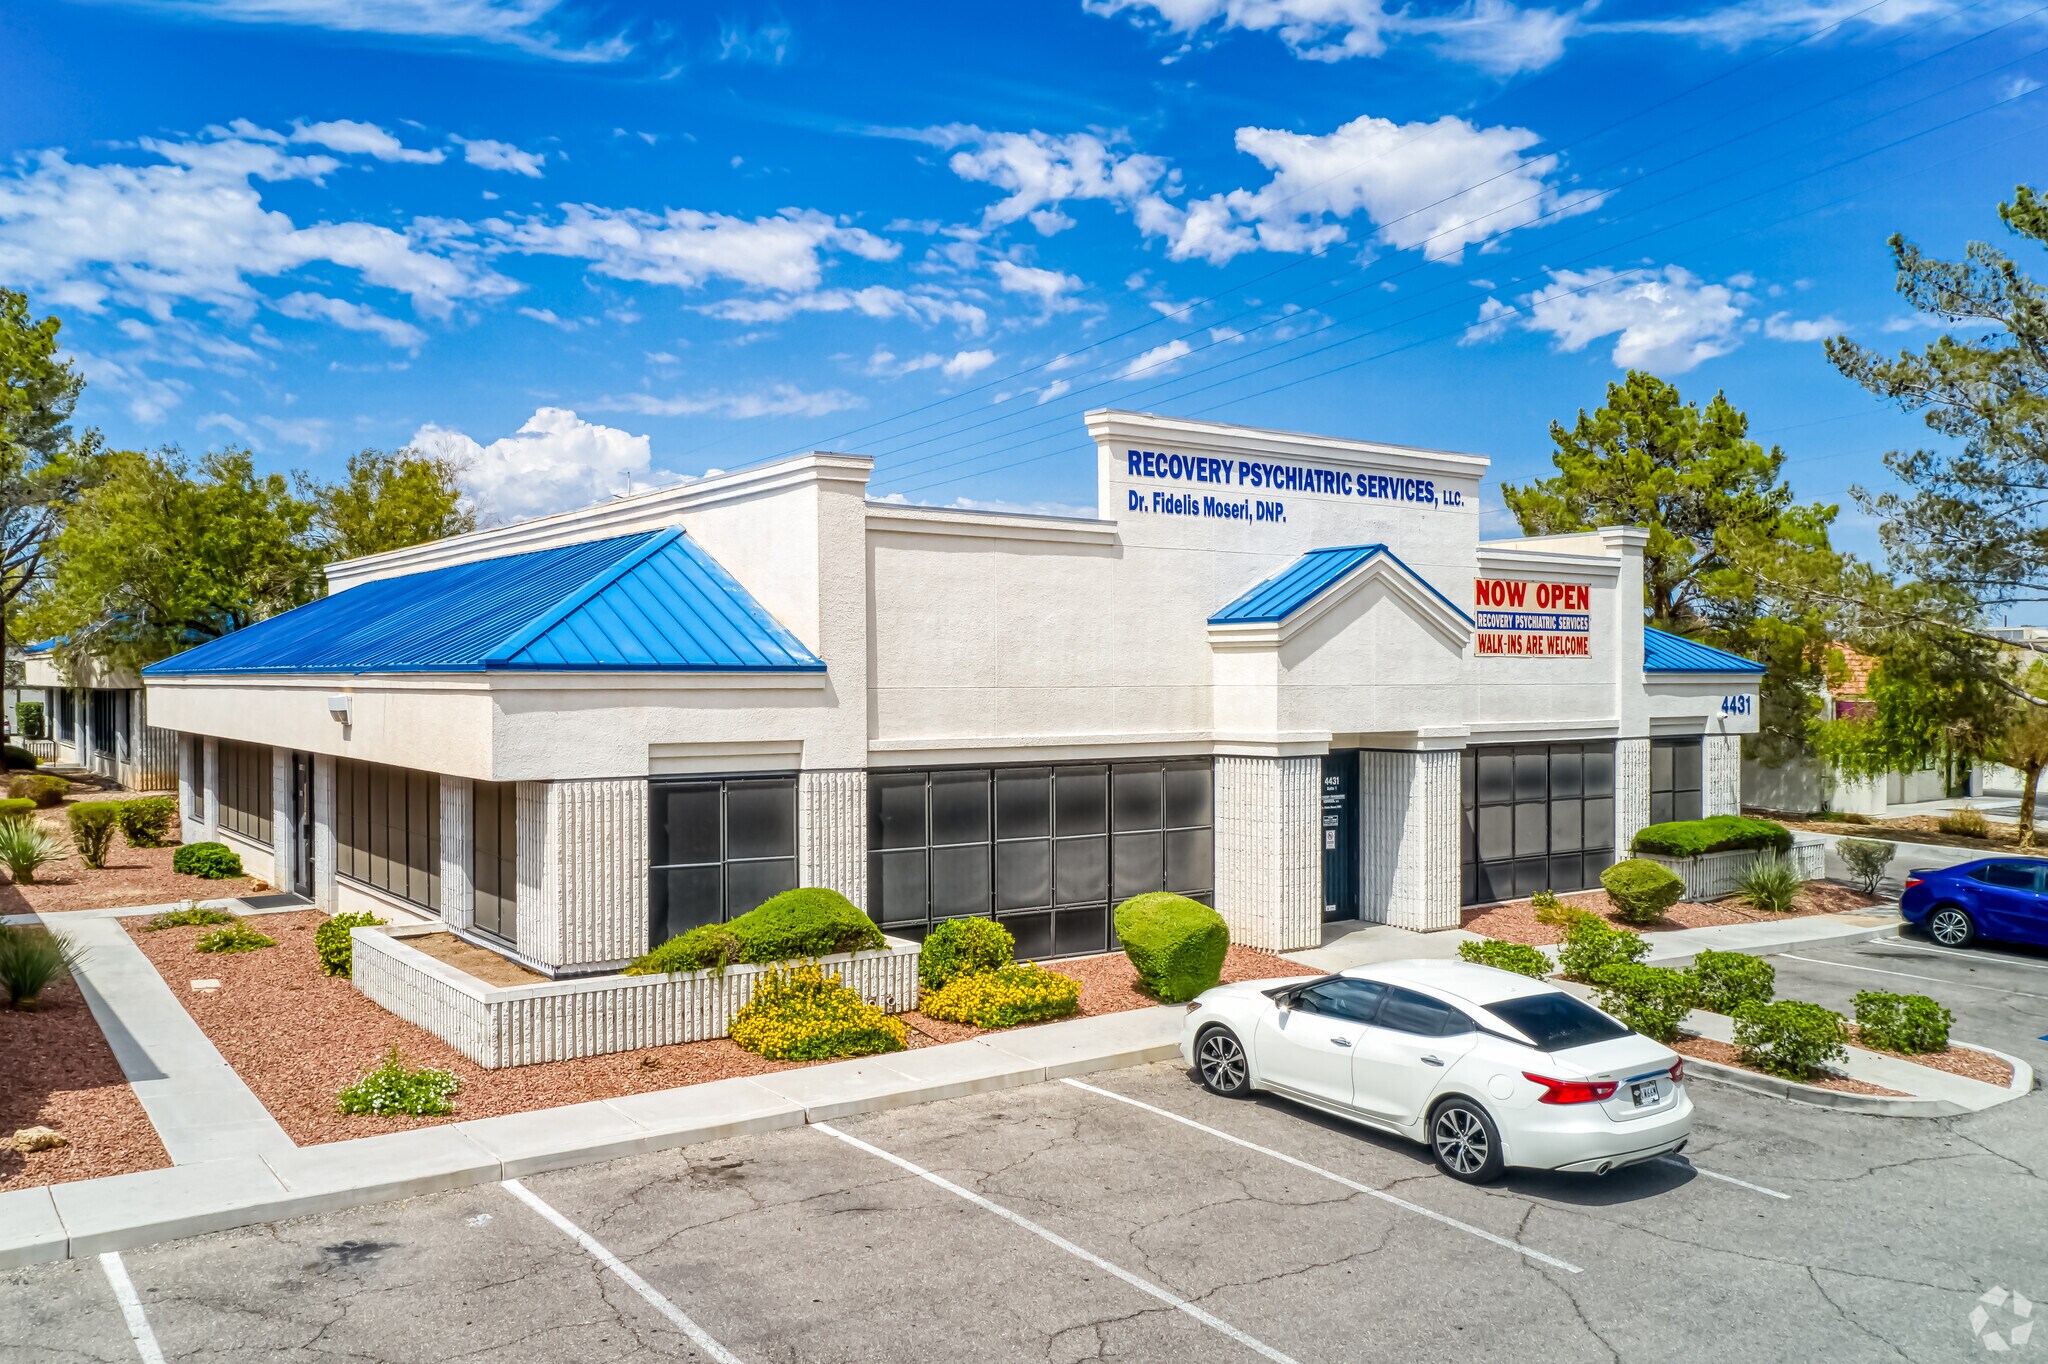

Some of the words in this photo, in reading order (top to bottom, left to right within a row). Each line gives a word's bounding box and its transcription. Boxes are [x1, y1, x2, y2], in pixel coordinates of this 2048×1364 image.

[1128, 450, 1234, 484] RECOVERY
[1239, 462, 1352, 496] PSYCHIATRIC
[1357, 474, 1438, 509] SERVICES,
[1443, 489, 1465, 507] LLC.
[1128, 490, 1148, 512] Dr.
[1153, 492, 1199, 515] Fidelis
[1203, 496, 1252, 525] Moseri,
[1256, 501, 1286, 523] DNP.
[1476, 579, 1527, 607] NOW
[1536, 583, 1589, 610] OPEN
[1478, 613, 1513, 628] RECOVERY
[1515, 615, 1557, 630] PSYCHIATRIC
[1558, 617, 1588, 631] SERVICES
[1477, 633, 1523, 654] WALK-INS
[1525, 635, 1544, 655] ARE
[1546, 635, 1589, 656] WELCOME
[1721, 695, 1751, 716] 4431
[1324, 776, 1340, 786] 4431
